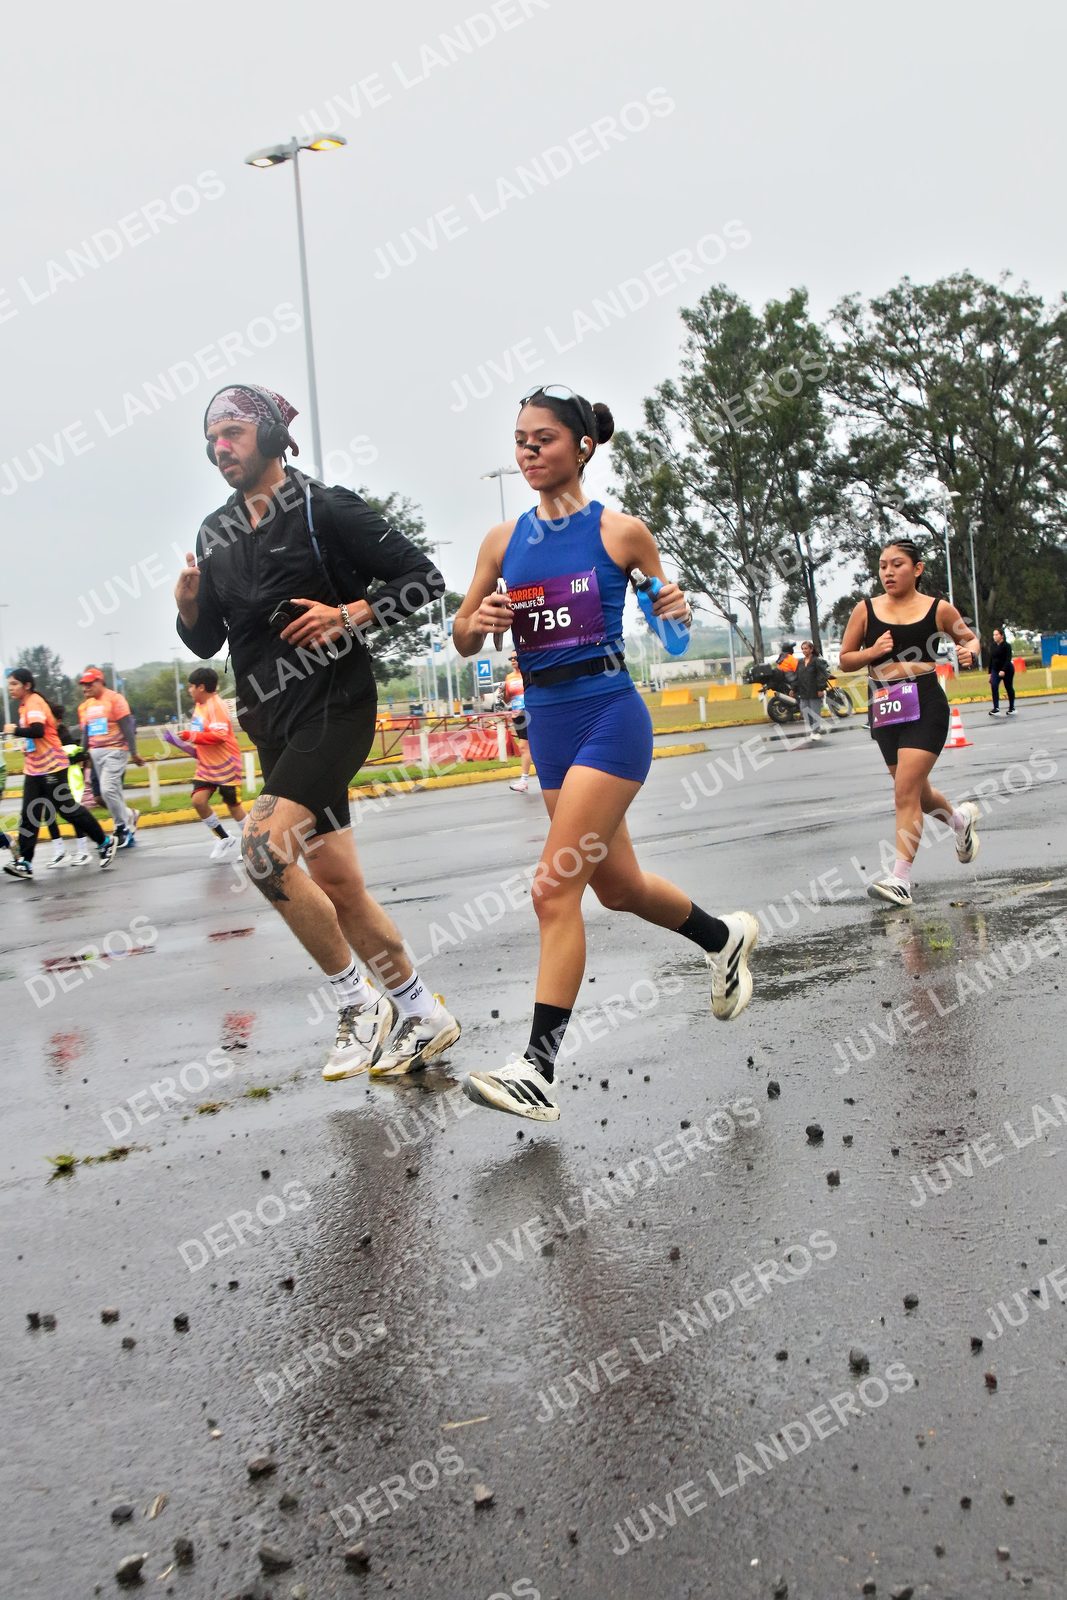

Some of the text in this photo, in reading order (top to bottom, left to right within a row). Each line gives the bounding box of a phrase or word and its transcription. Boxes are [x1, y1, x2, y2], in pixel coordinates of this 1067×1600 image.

[508, 586, 544, 602] CARRERA
[529, 607, 572, 632] 736
[880, 701, 901, 715] 570
